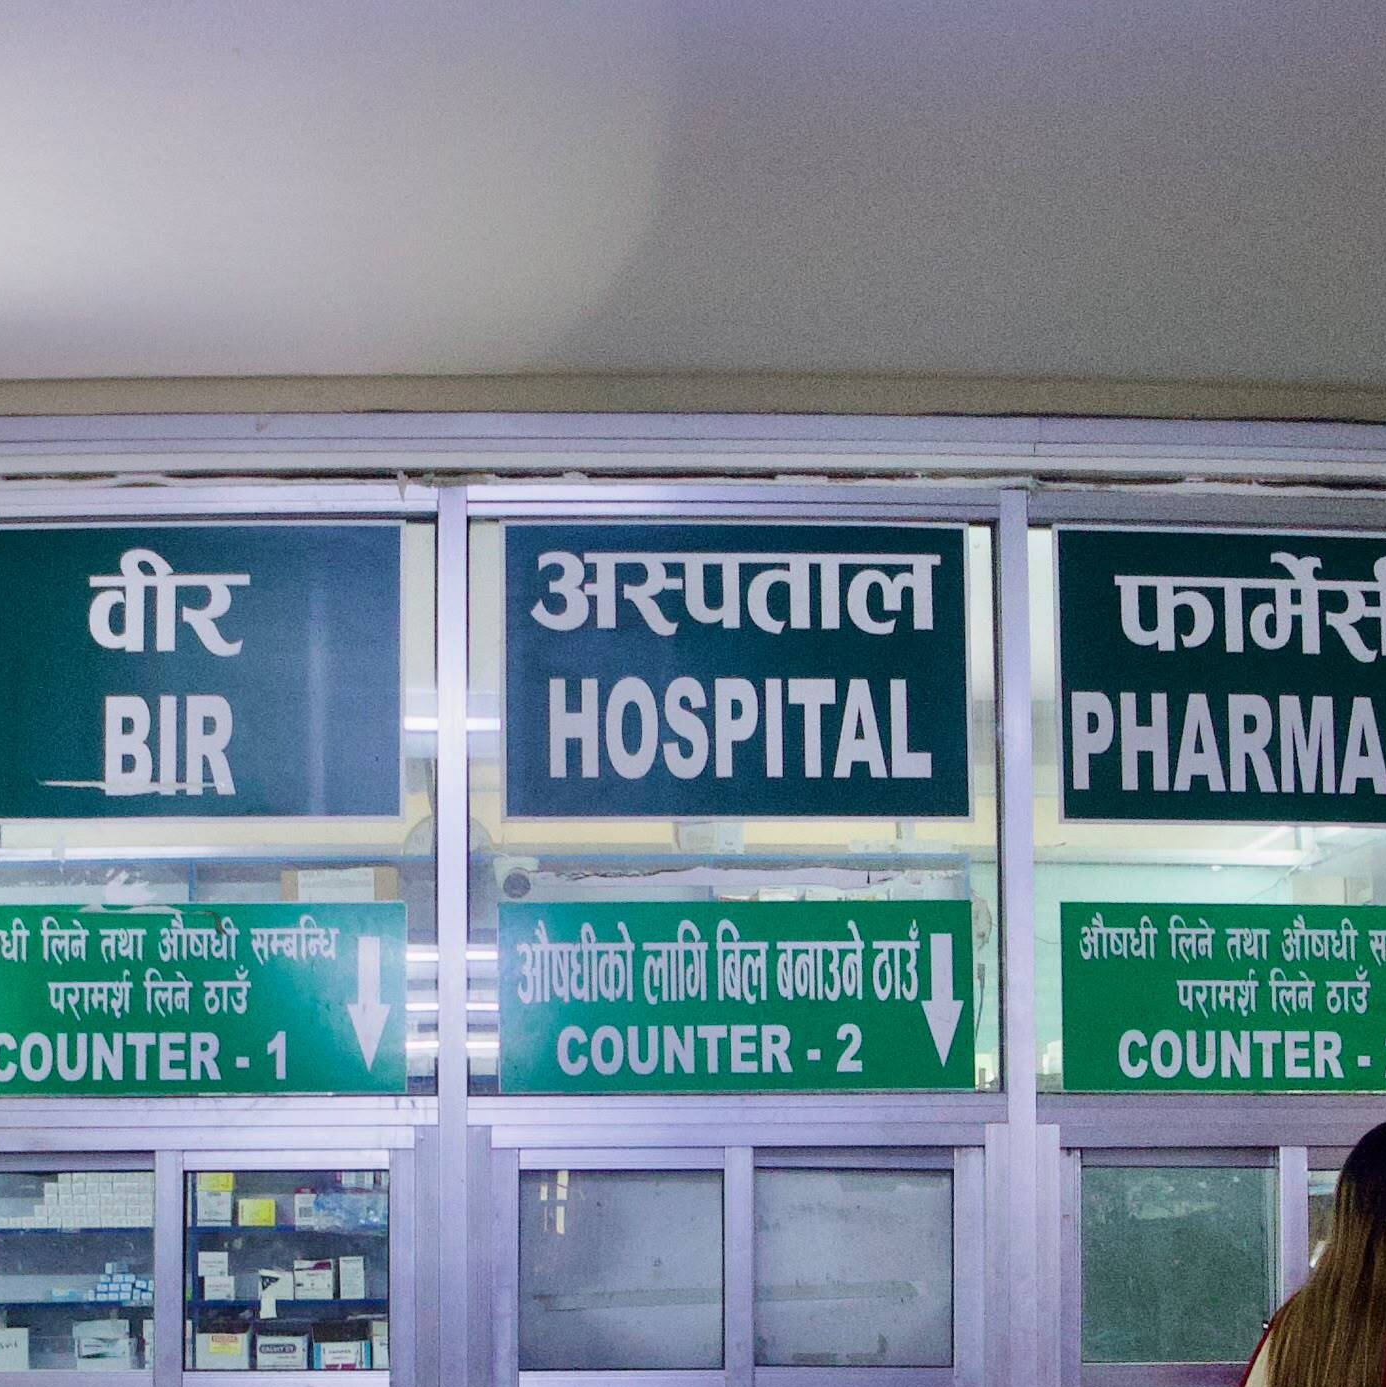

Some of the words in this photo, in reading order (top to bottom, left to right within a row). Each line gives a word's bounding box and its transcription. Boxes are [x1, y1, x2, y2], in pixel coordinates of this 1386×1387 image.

[88, 547, 251, 657] वीर
[530, 548, 939, 636] अस्पताल
[104, 693, 236, 797] BIR
[549, 677, 932, 781] HOSPITAL
[42, 918, 89, 966] लिने
[100, 928, 146, 963] तथा
[158, 910, 239, 964] औषधी
[251, 915, 339, 966] सम्बन्धि
[516, 919, 635, 1003] औषधीको
[643, 918, 708, 1006] लागि
[716, 918, 769, 1005] बिल
[776, 919, 865, 1002] बनाउने
[872, 918, 920, 1001] ठाउँ
[1079, 912, 1157, 961] औषधी
[1168, 915, 1215, 964] लिने
[1226, 928, 1270, 963] तथा
[1281, 914, 1358, 962] औषधी
[48, 970, 132, 1021] परामर्श
[144, 968, 192, 1016] लिने
[204, 964, 251, 1015] ठाउँ
[1177, 969, 1259, 1018] परामर्श
[1269, 967, 1315, 1016] लिने
[1326, 964, 1371, 1015] ठाउँ
[267, 1031, 287, 1080] 1
[556, 1024, 793, 1075] COUNTER
[836, 1023, 863, 1073] 2
[1118, 1029, 1344, 1079] COUNTER
